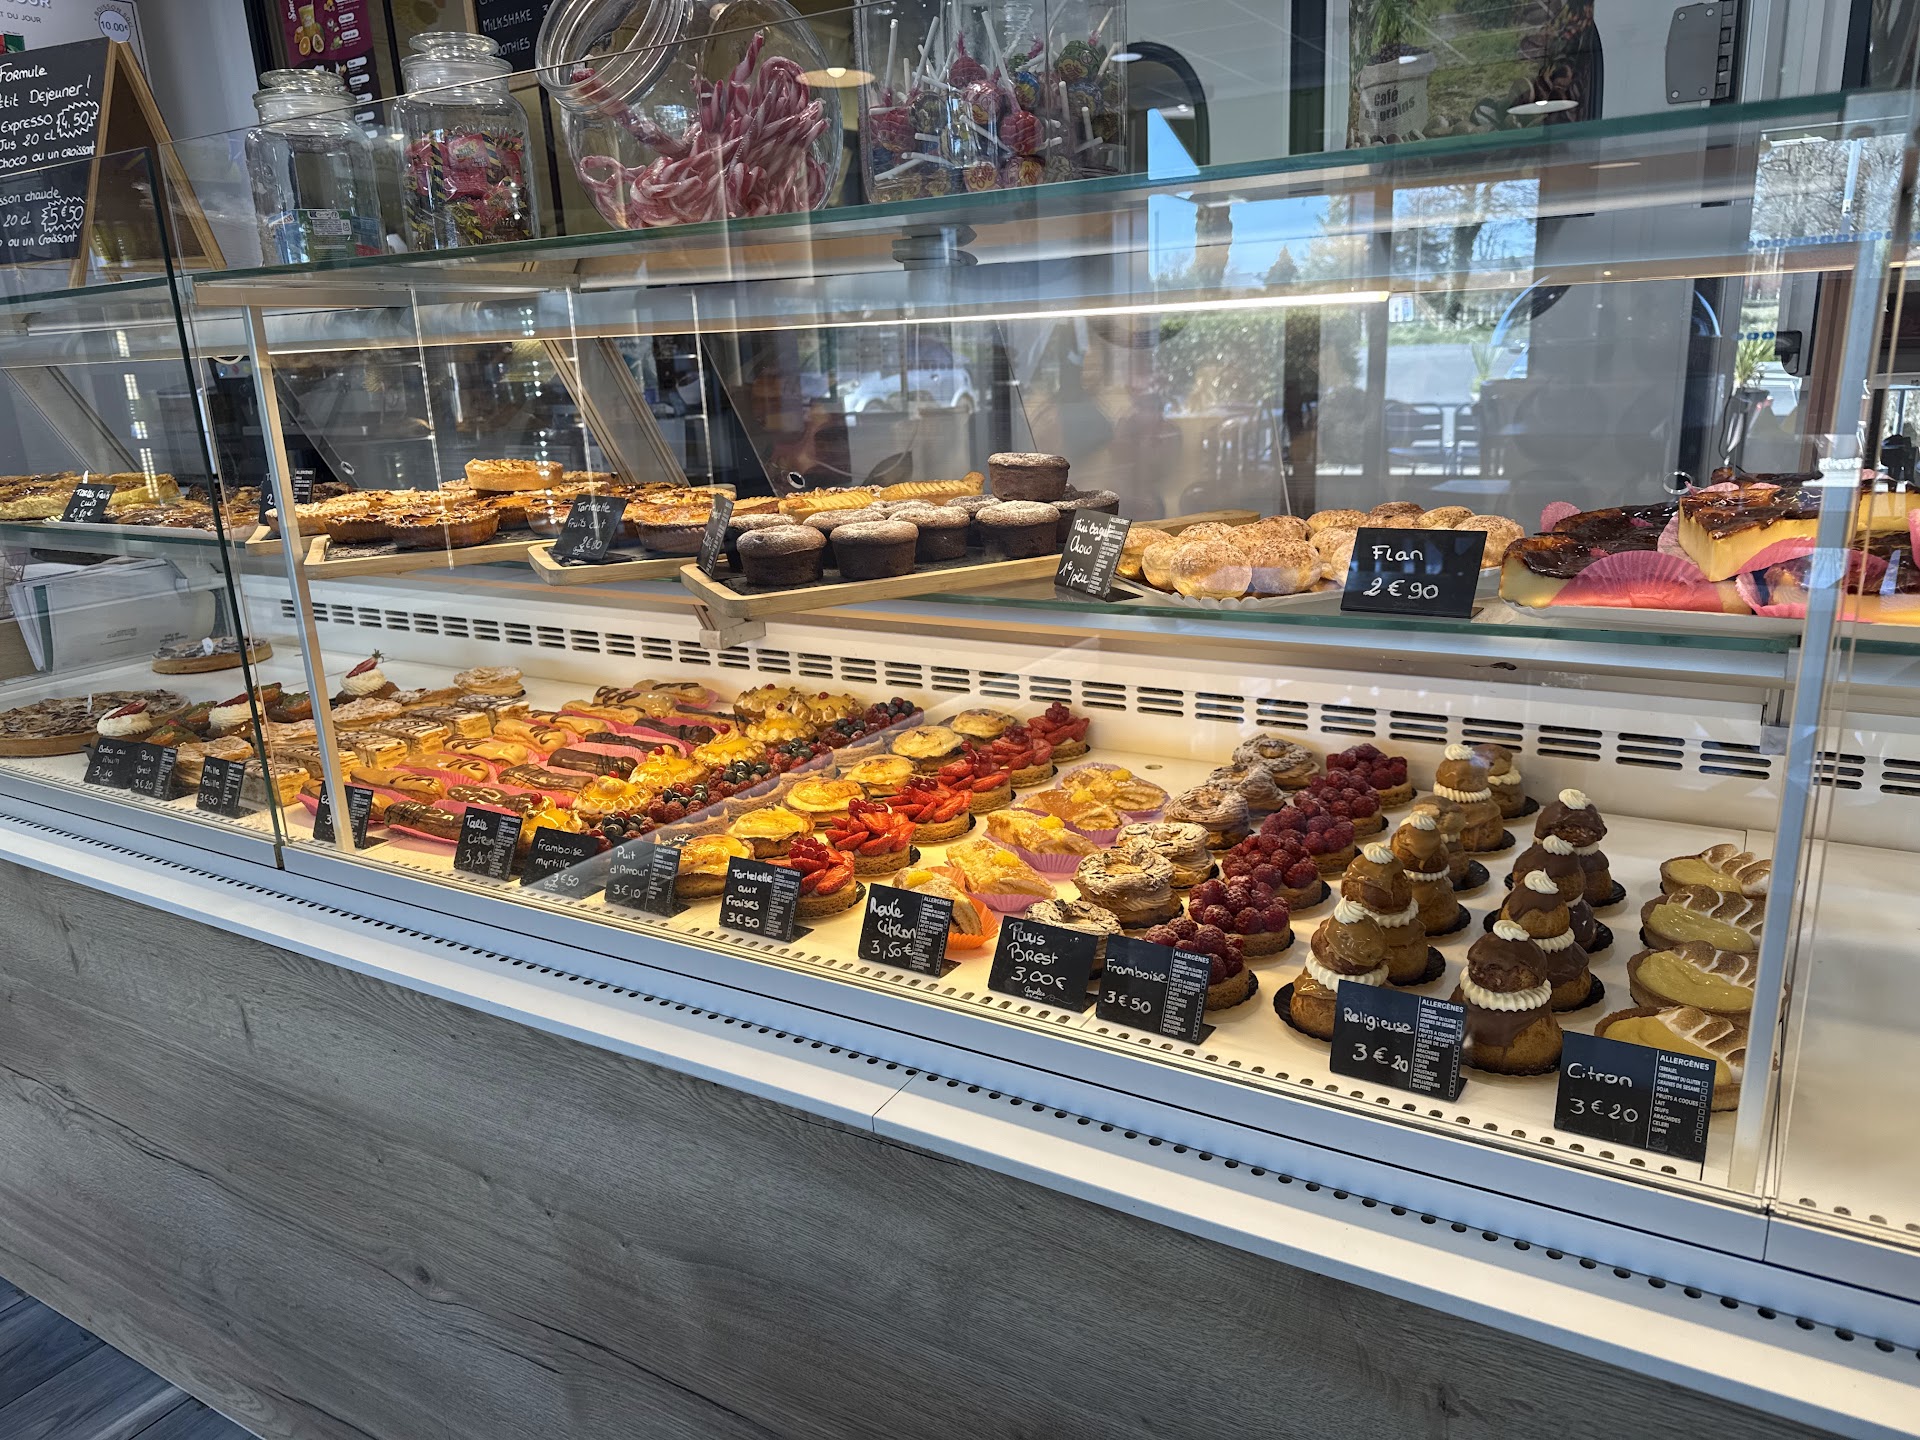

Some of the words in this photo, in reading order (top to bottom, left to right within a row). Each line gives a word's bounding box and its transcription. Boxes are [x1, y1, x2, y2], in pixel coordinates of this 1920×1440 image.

[21, 15, 41, 24] JOUR
[1371, 544, 1424, 562] Flan
[737, 885, 758, 894] aux
[1106, 958, 1168, 984] Framboise
[1421, 999, 1464, 1013] ALLERGÈNES
[1343, 1006, 1415, 1034] Religieuse
[1659, 1054, 1710, 1071] ALLERGÈNES
[1567, 1062, 1632, 1088] Citron
